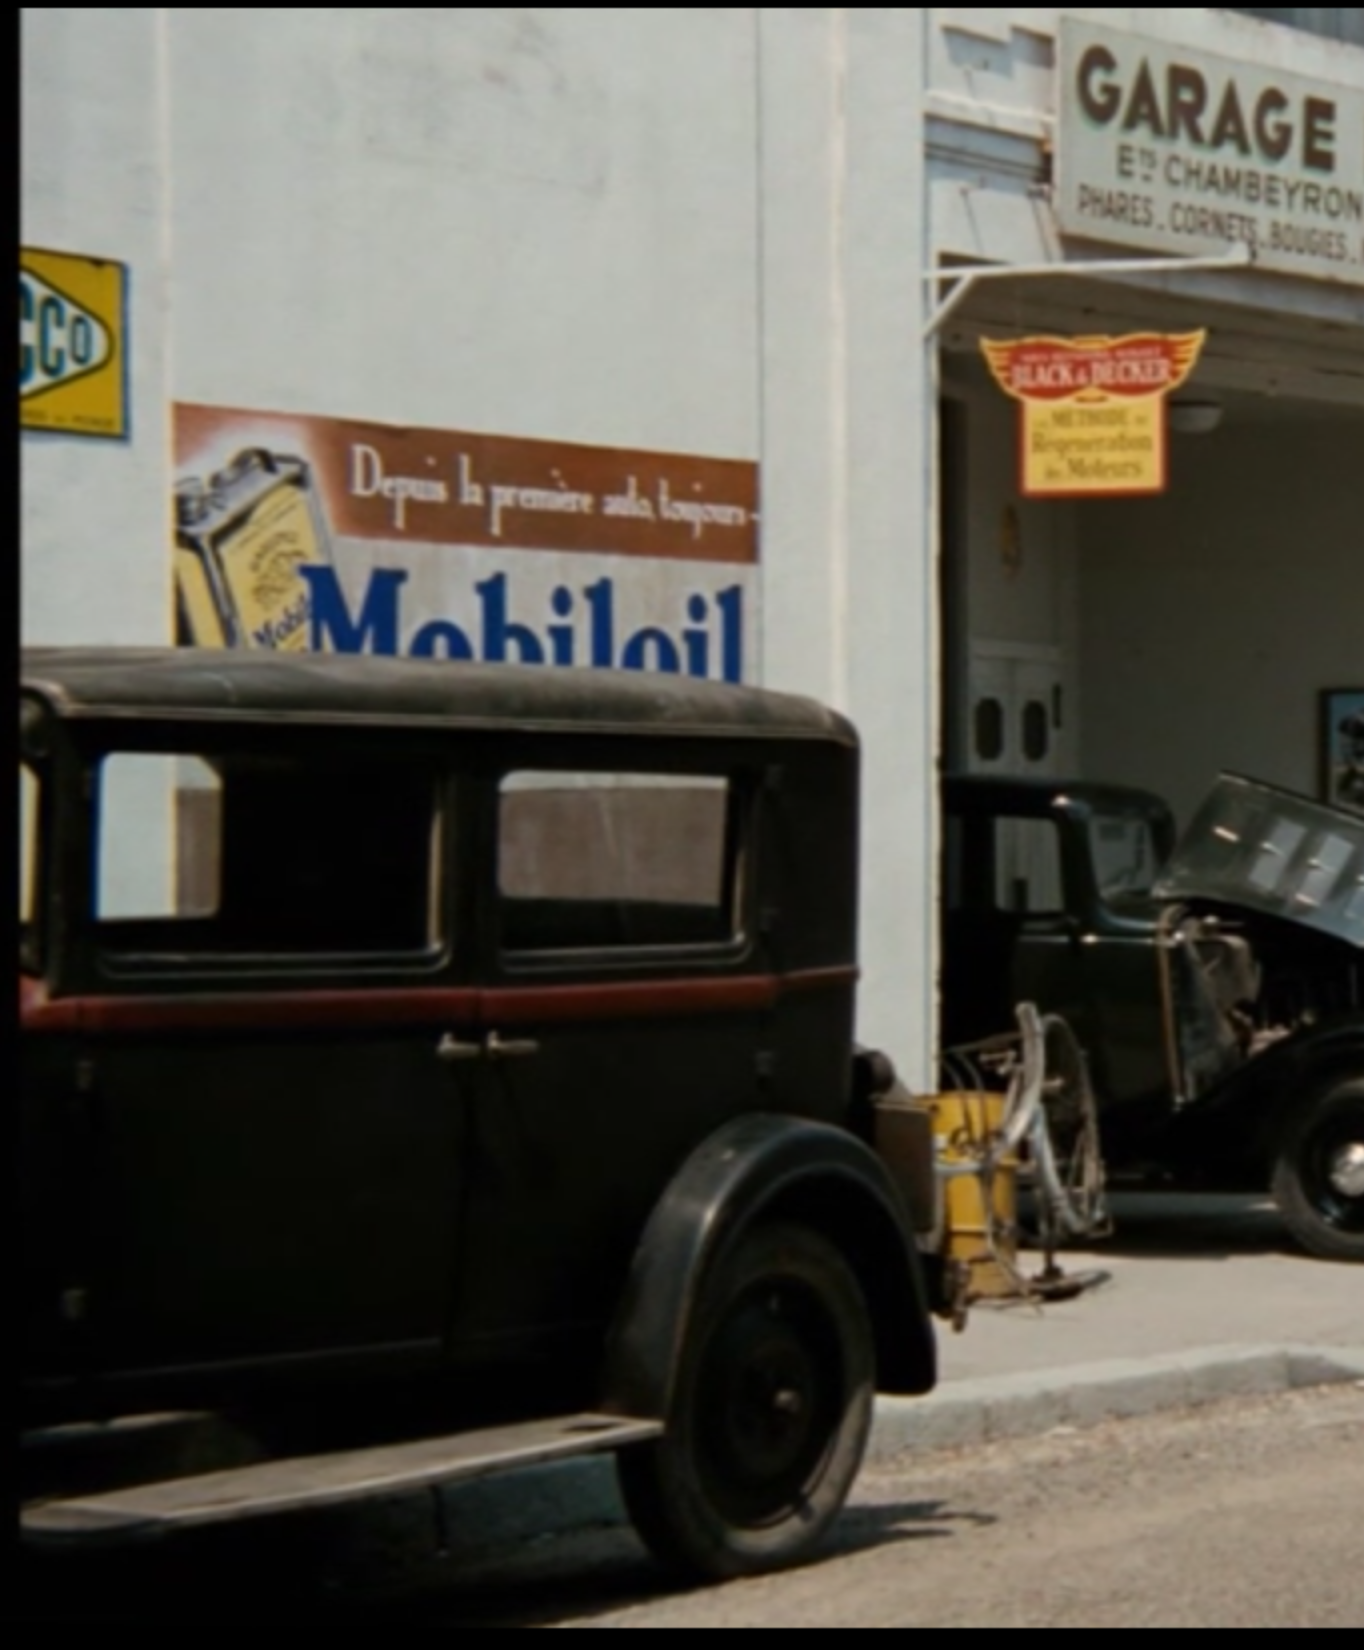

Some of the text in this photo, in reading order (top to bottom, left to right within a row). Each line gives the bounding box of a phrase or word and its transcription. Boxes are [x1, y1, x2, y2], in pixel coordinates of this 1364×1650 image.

[1077, 44, 1336, 171] GARAGE
[1164, 153, 1362, 222] CHAMBEYRON
[1012, 361, 1073, 388] BLACK
[350, 443, 448, 531] Depuis
[458, 453, 484, 507] la
[490, 467, 594, 538] première
[295, 563, 743, 684] Mobiloil
